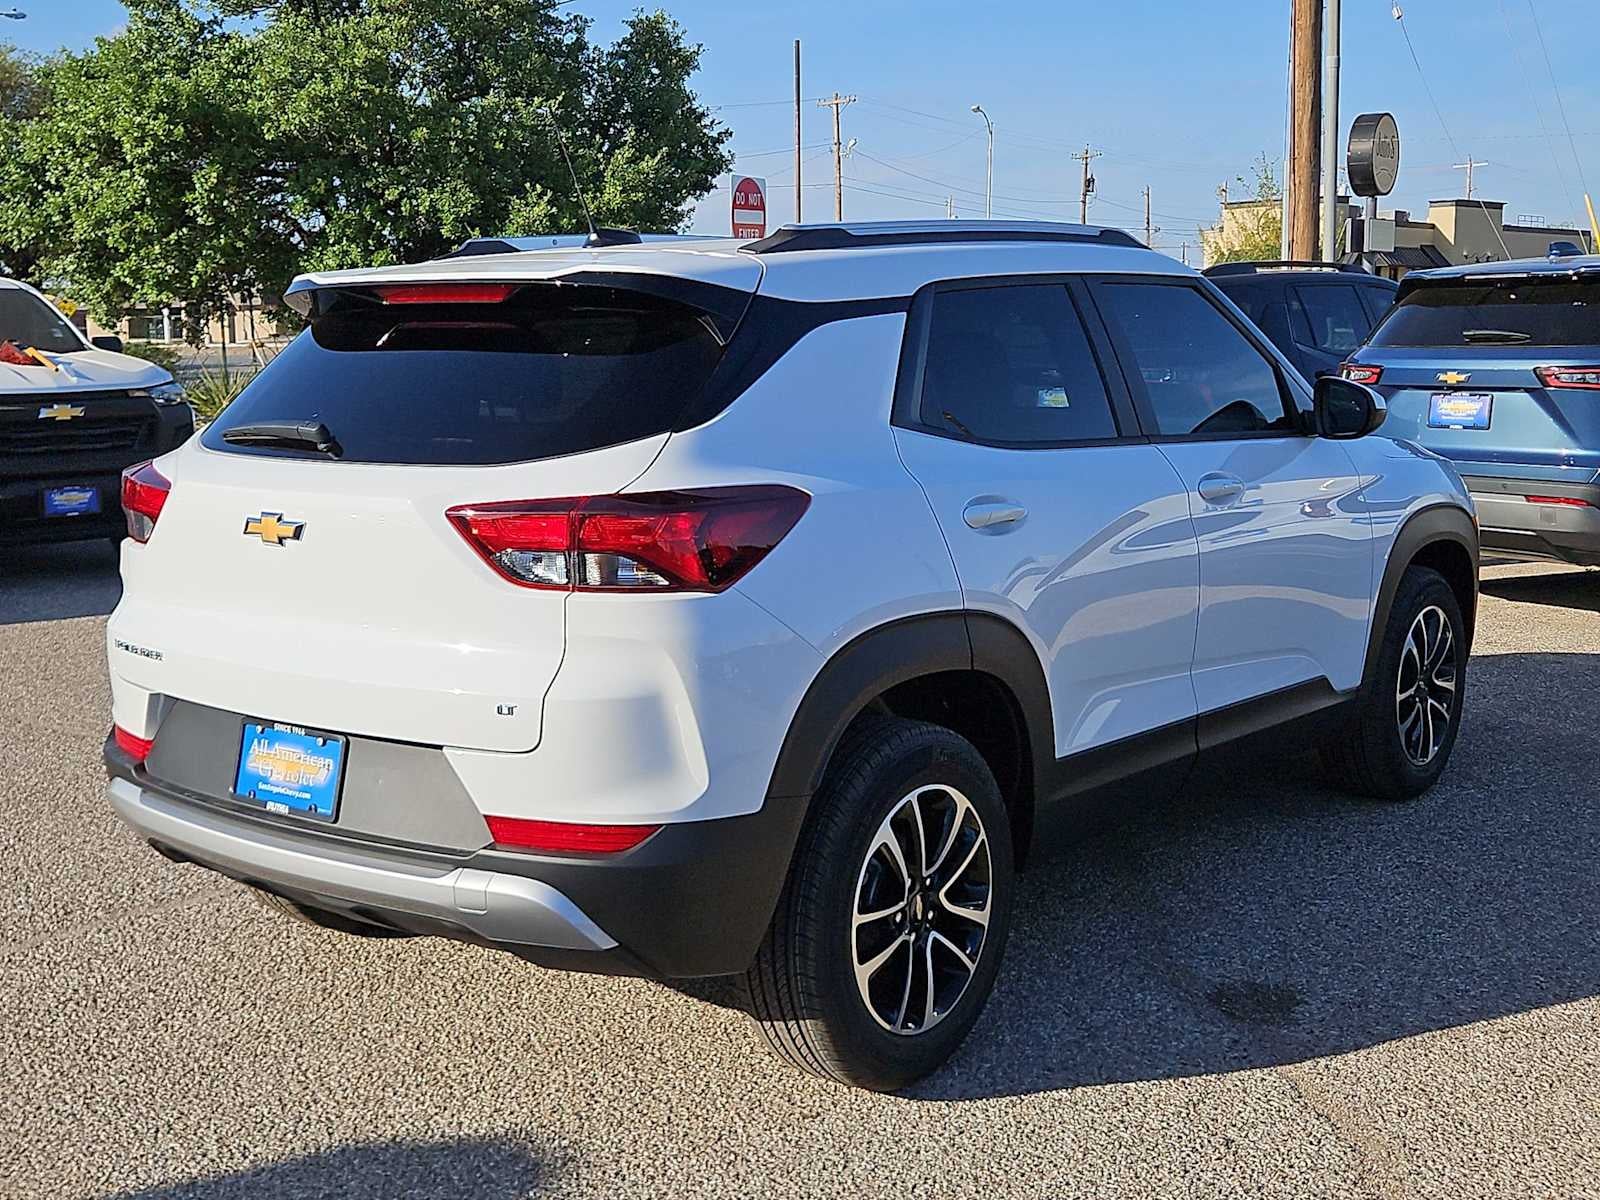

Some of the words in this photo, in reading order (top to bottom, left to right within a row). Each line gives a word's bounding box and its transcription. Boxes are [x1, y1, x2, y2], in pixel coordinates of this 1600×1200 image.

[735, 191, 745, 205] DO
[748, 193, 761, 206] NOT
[738, 228, 760, 239] ENTER
[248, 737, 270, 756] All
[271, 741, 334, 770] American
